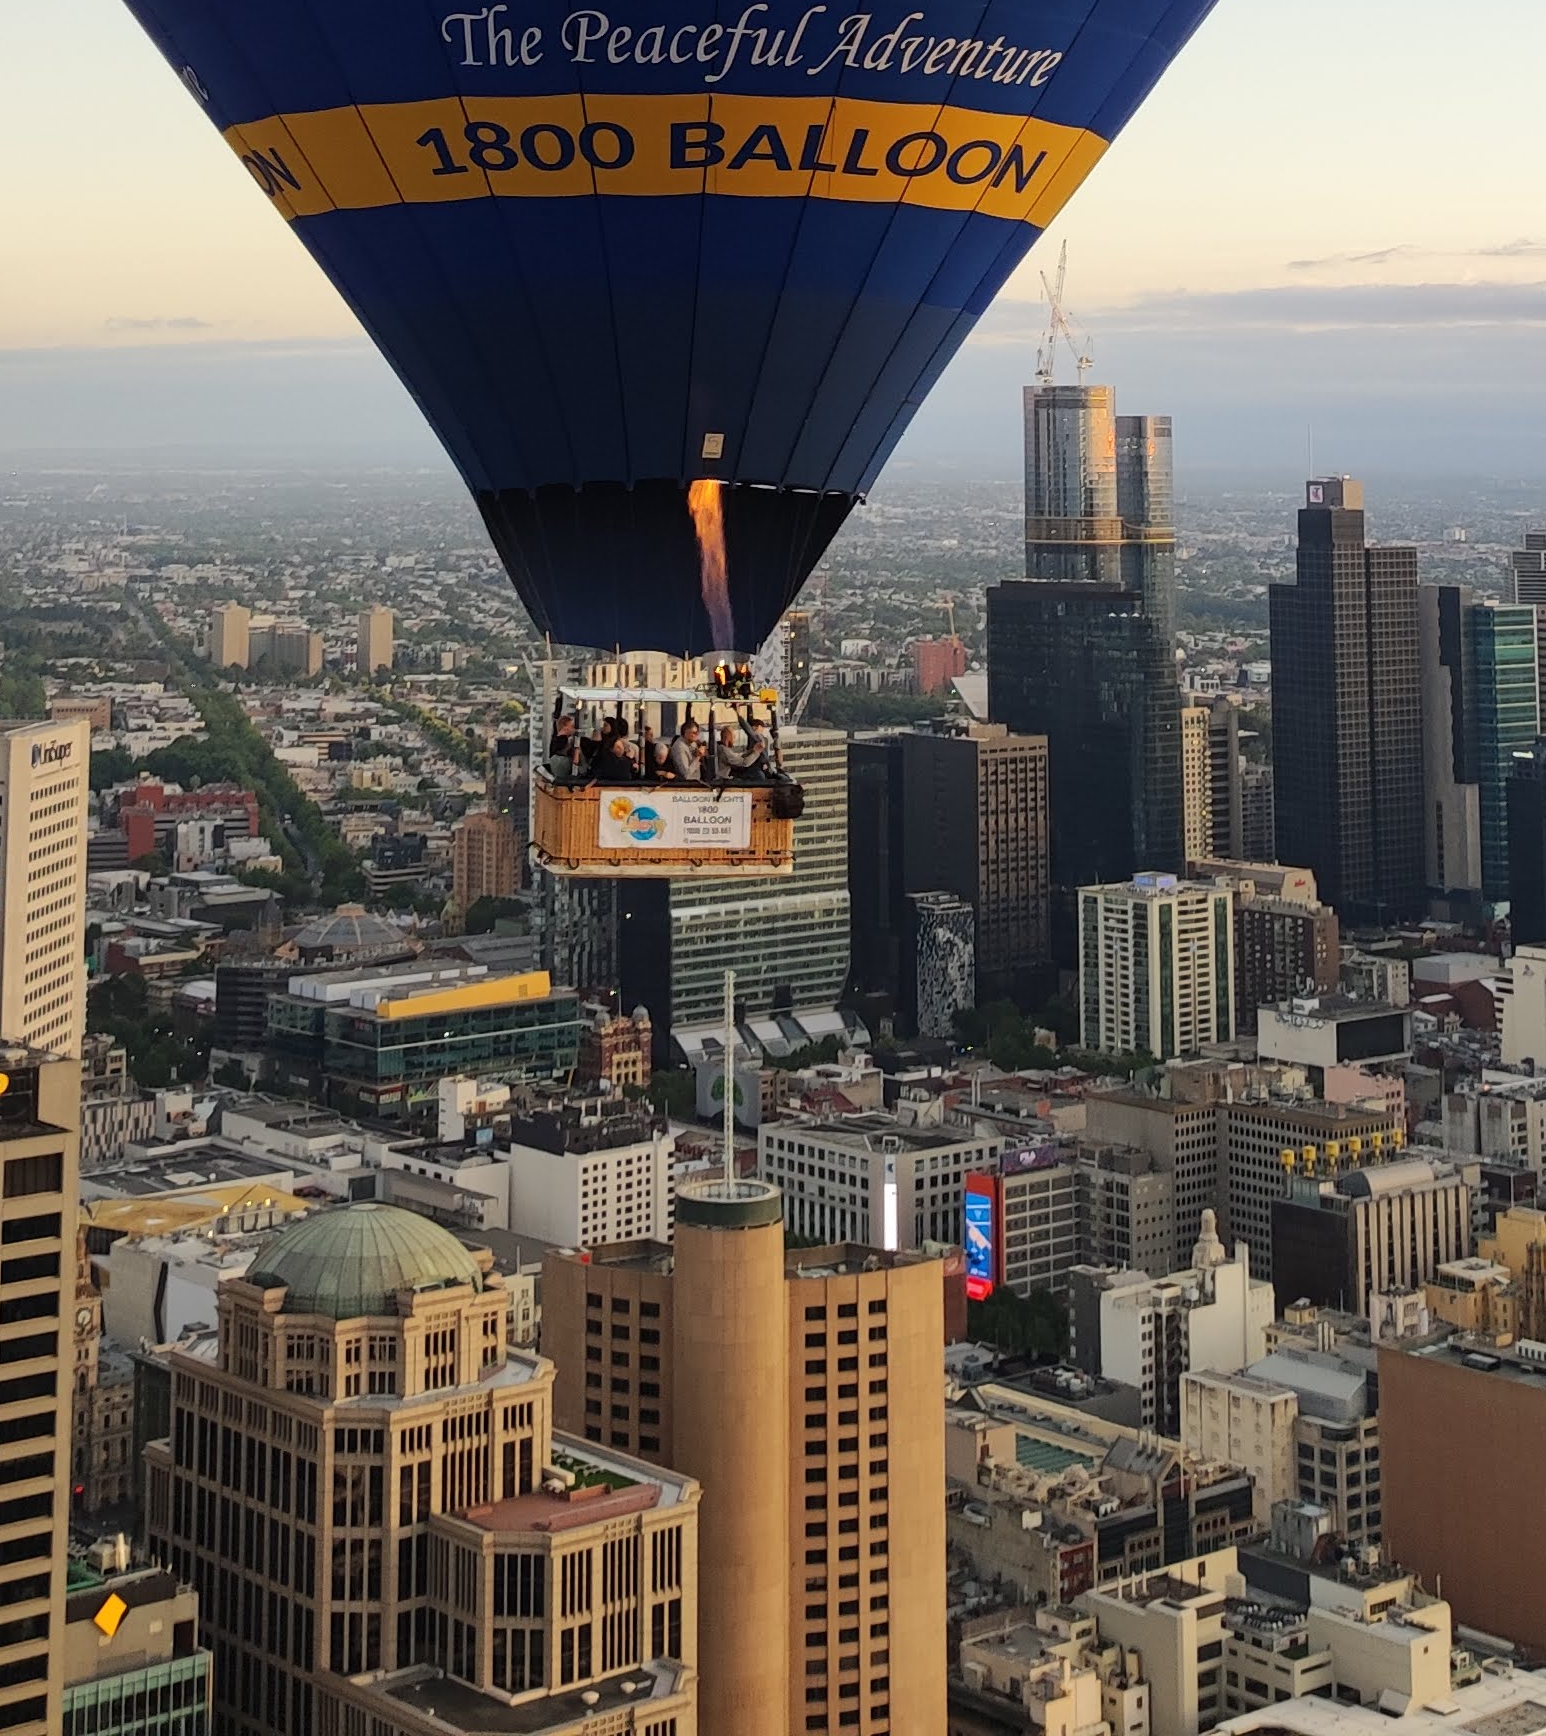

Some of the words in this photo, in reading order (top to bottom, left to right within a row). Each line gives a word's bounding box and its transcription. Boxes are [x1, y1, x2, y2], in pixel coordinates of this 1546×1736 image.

[441, 5, 543, 66] The
[561, 4, 826, 82] Peaceful
[807, 12, 1063, 87] Adventure
[416, 122, 635, 175] 1800
[669, 122, 1048, 194] BALLOON
[683, 815, 732, 824] BALLOON
